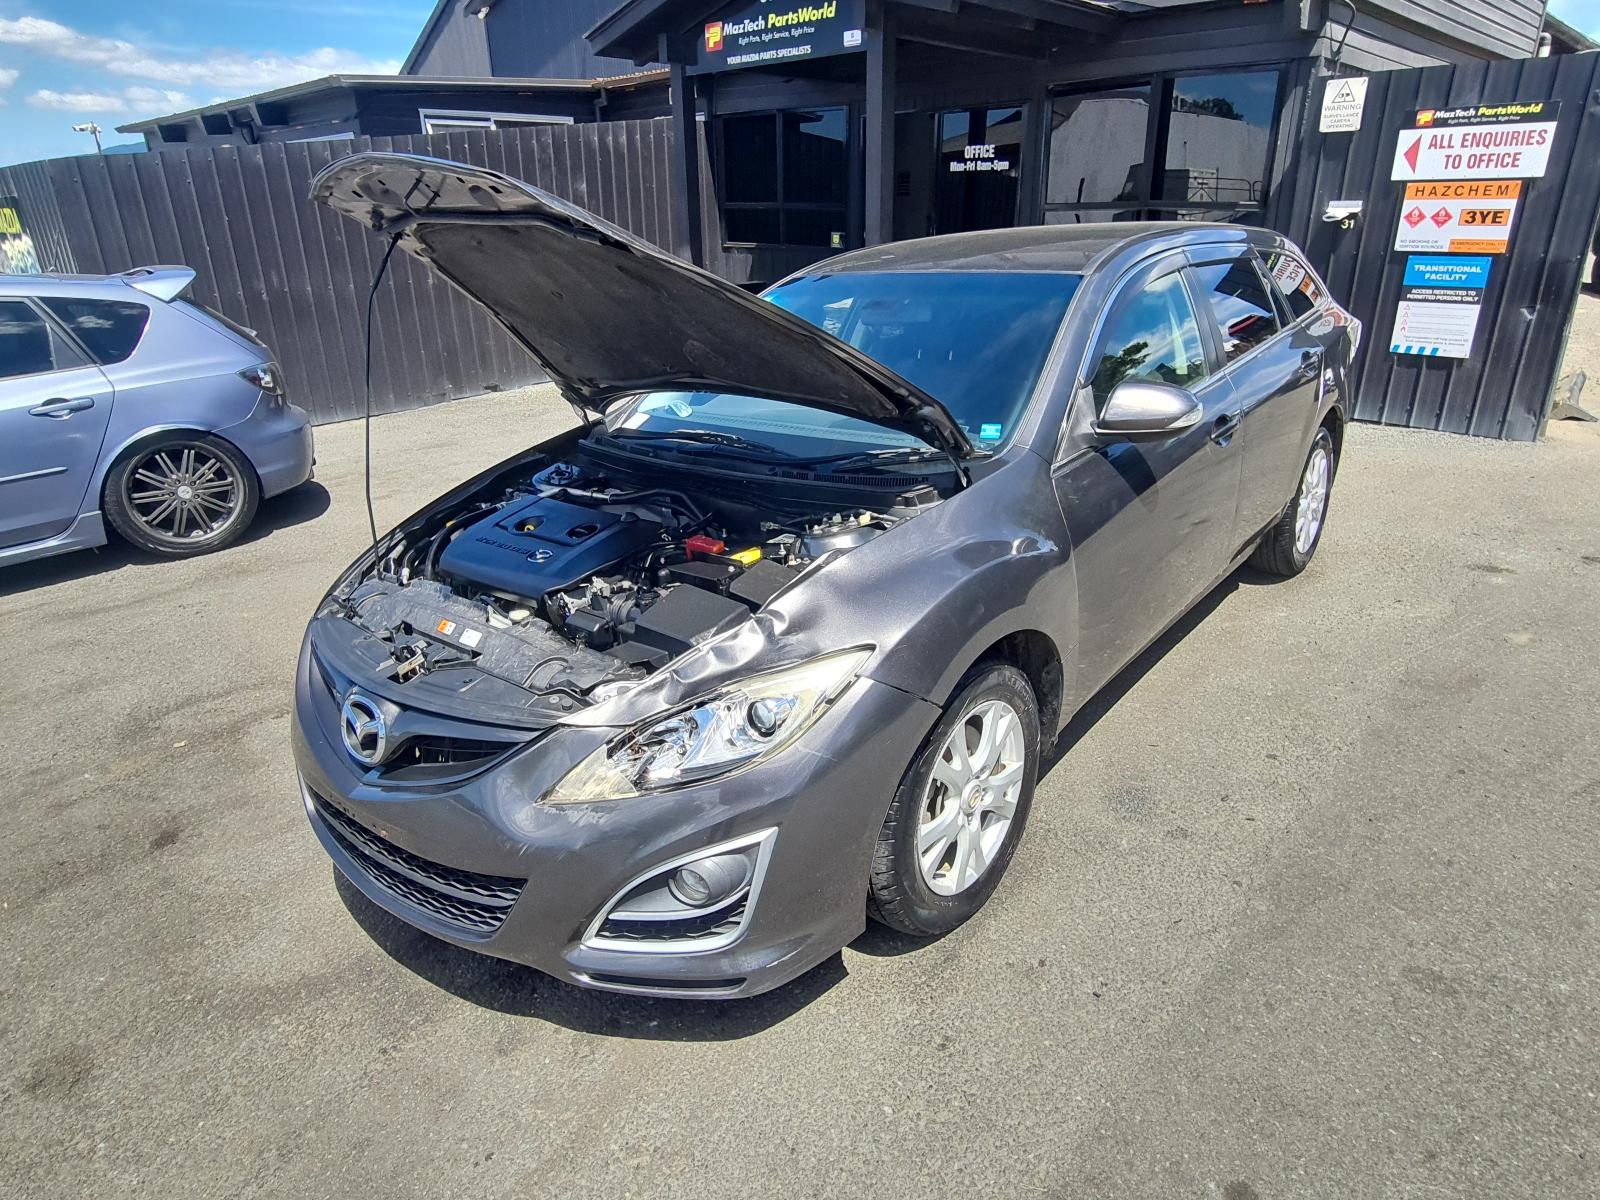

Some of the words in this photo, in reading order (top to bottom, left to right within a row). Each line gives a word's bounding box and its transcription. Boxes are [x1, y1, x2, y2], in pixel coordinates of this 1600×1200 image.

[723, 15, 766, 36] MazTech
[767, 1, 837, 28] PartsWorld
[791, 27, 803, 37] Right
[760, 50, 777, 60] PARTS
[777, 45, 812, 58] SPECIALISTS
[1324, 103, 1361, 111] WARNING
[1434, 107, 1476, 119] MazTech
[1477, 103, 1544, 116] PartsWorld
[1428, 133, 1455, 150] ALL
[1460, 129, 1548, 149] ENQUIRIES
[964, 144, 995, 159] OFFICE
[949, 161, 976, 172] Mon-Fri
[1444, 154, 1462, 170] TO
[1466, 152, 1522, 169] OFFICE
[1415, 185, 1510, 197] HAZCHEM
[1464, 210, 1504, 224] 3YE
[1414, 264, 1482, 273] TRANSITIONAL
[1424, 273, 1467, 281] FACILITY
